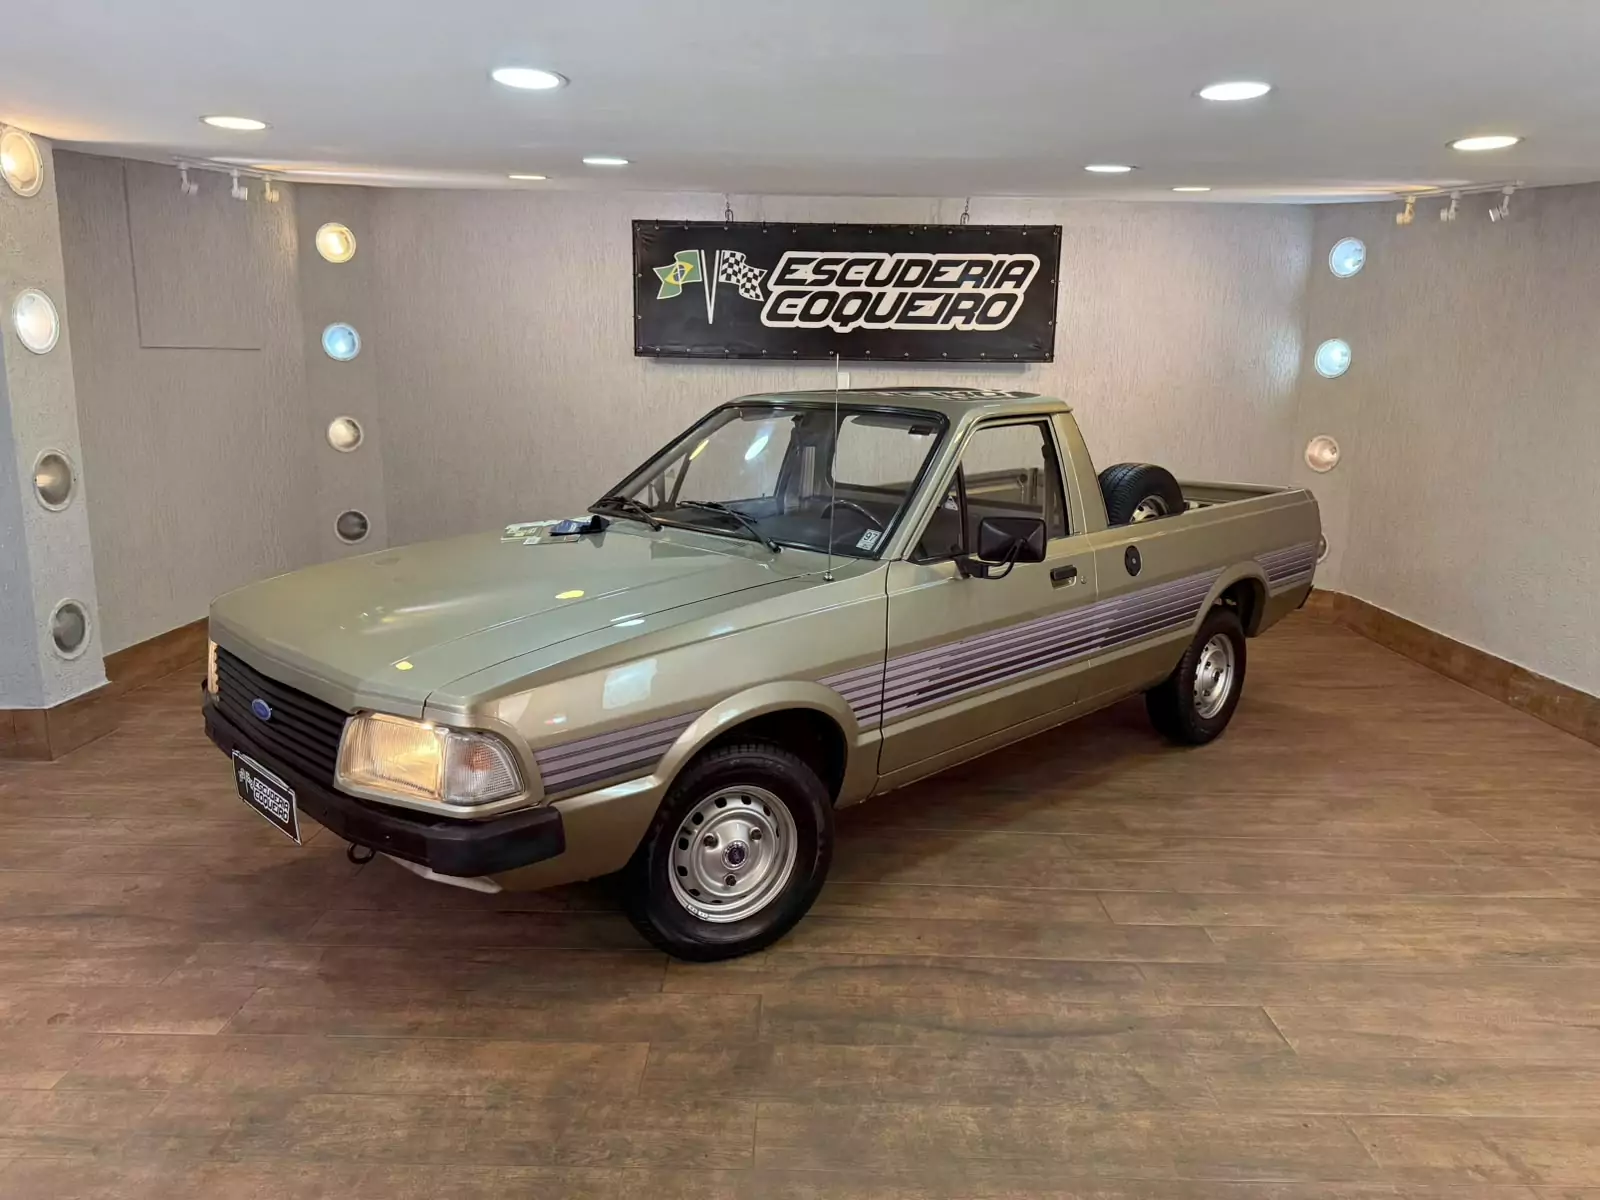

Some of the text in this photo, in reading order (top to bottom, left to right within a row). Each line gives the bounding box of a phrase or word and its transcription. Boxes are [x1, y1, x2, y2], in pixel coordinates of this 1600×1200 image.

[771, 255, 1036, 289] ESCUDERIA
[764, 290, 1019, 328] COQUEIRO
[863, 532, 878, 542] 97
[254, 779, 289, 811] ESCUDERIA
[254, 791, 289, 823] COQUEIRO
